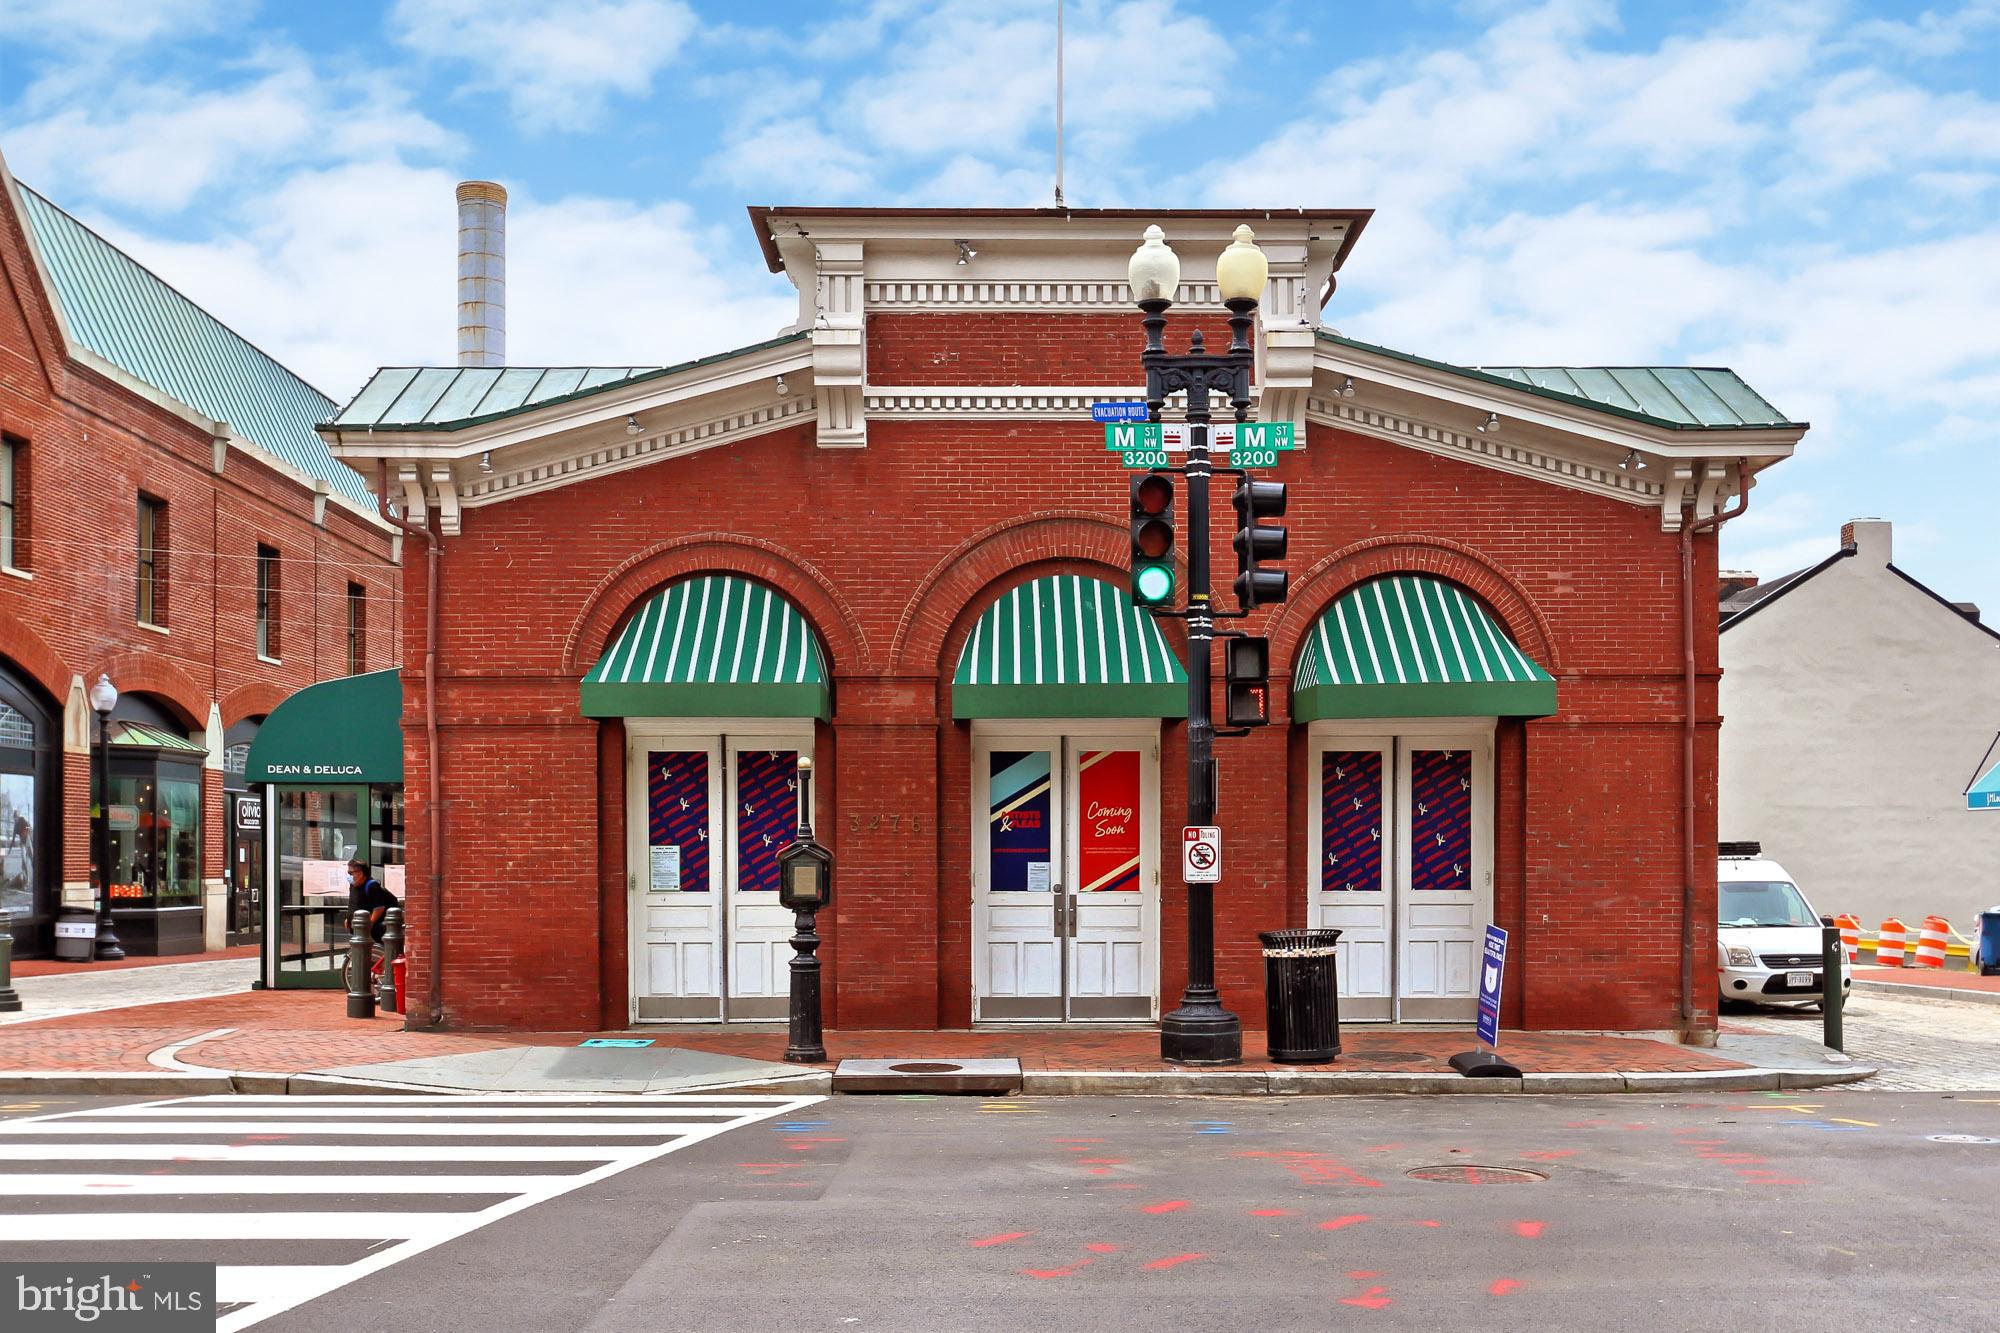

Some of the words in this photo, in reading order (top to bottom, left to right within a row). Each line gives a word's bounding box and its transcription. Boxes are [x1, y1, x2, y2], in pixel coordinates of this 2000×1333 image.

[1094, 406, 1127, 418] EVACUATION
[1128, 406, 1145, 417] ROUTE
[1114, 427, 1135, 447] M
[1144, 426, 1156, 437] ST
[1144, 438, 1157, 448] NW
[1245, 427, 1265, 447] M
[1275, 425, 1288, 436] ST
[1274, 437, 1289, 447] NW
[1124, 452, 1168, 466] 3200
[1231, 451, 1275, 466] 3200
[267, 765, 300, 774] DEAN
[303, 765, 311, 774] &
[314, 765, 363, 775] DELUCA
[1087, 800, 1132, 823] Coming
[848, 812, 921, 832] 3276
[1094, 818, 1125, 837] Soon
[1187, 830, 1197, 839] NO
